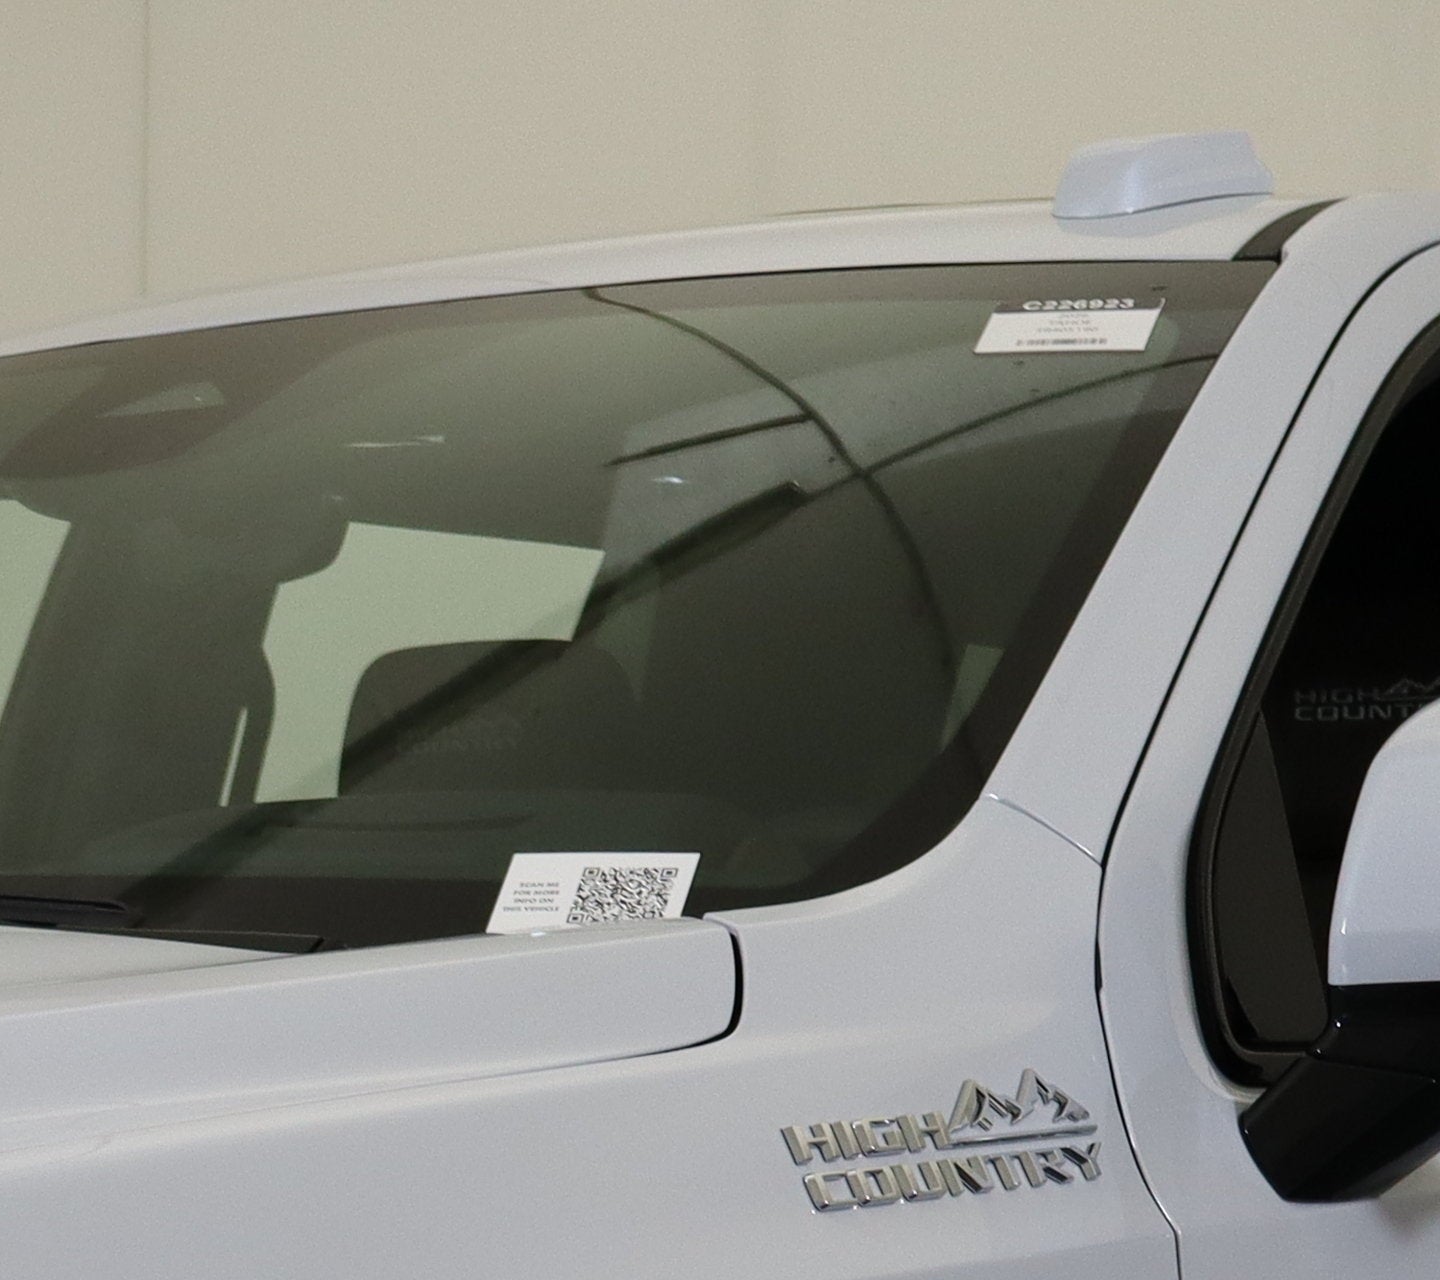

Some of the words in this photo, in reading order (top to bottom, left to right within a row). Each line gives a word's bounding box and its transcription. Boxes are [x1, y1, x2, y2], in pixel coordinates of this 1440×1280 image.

[1294, 704, 1413, 722] COUNT
[780, 1110, 953, 1166] HIGH
[802, 1142, 1103, 1212] COUNTRY
